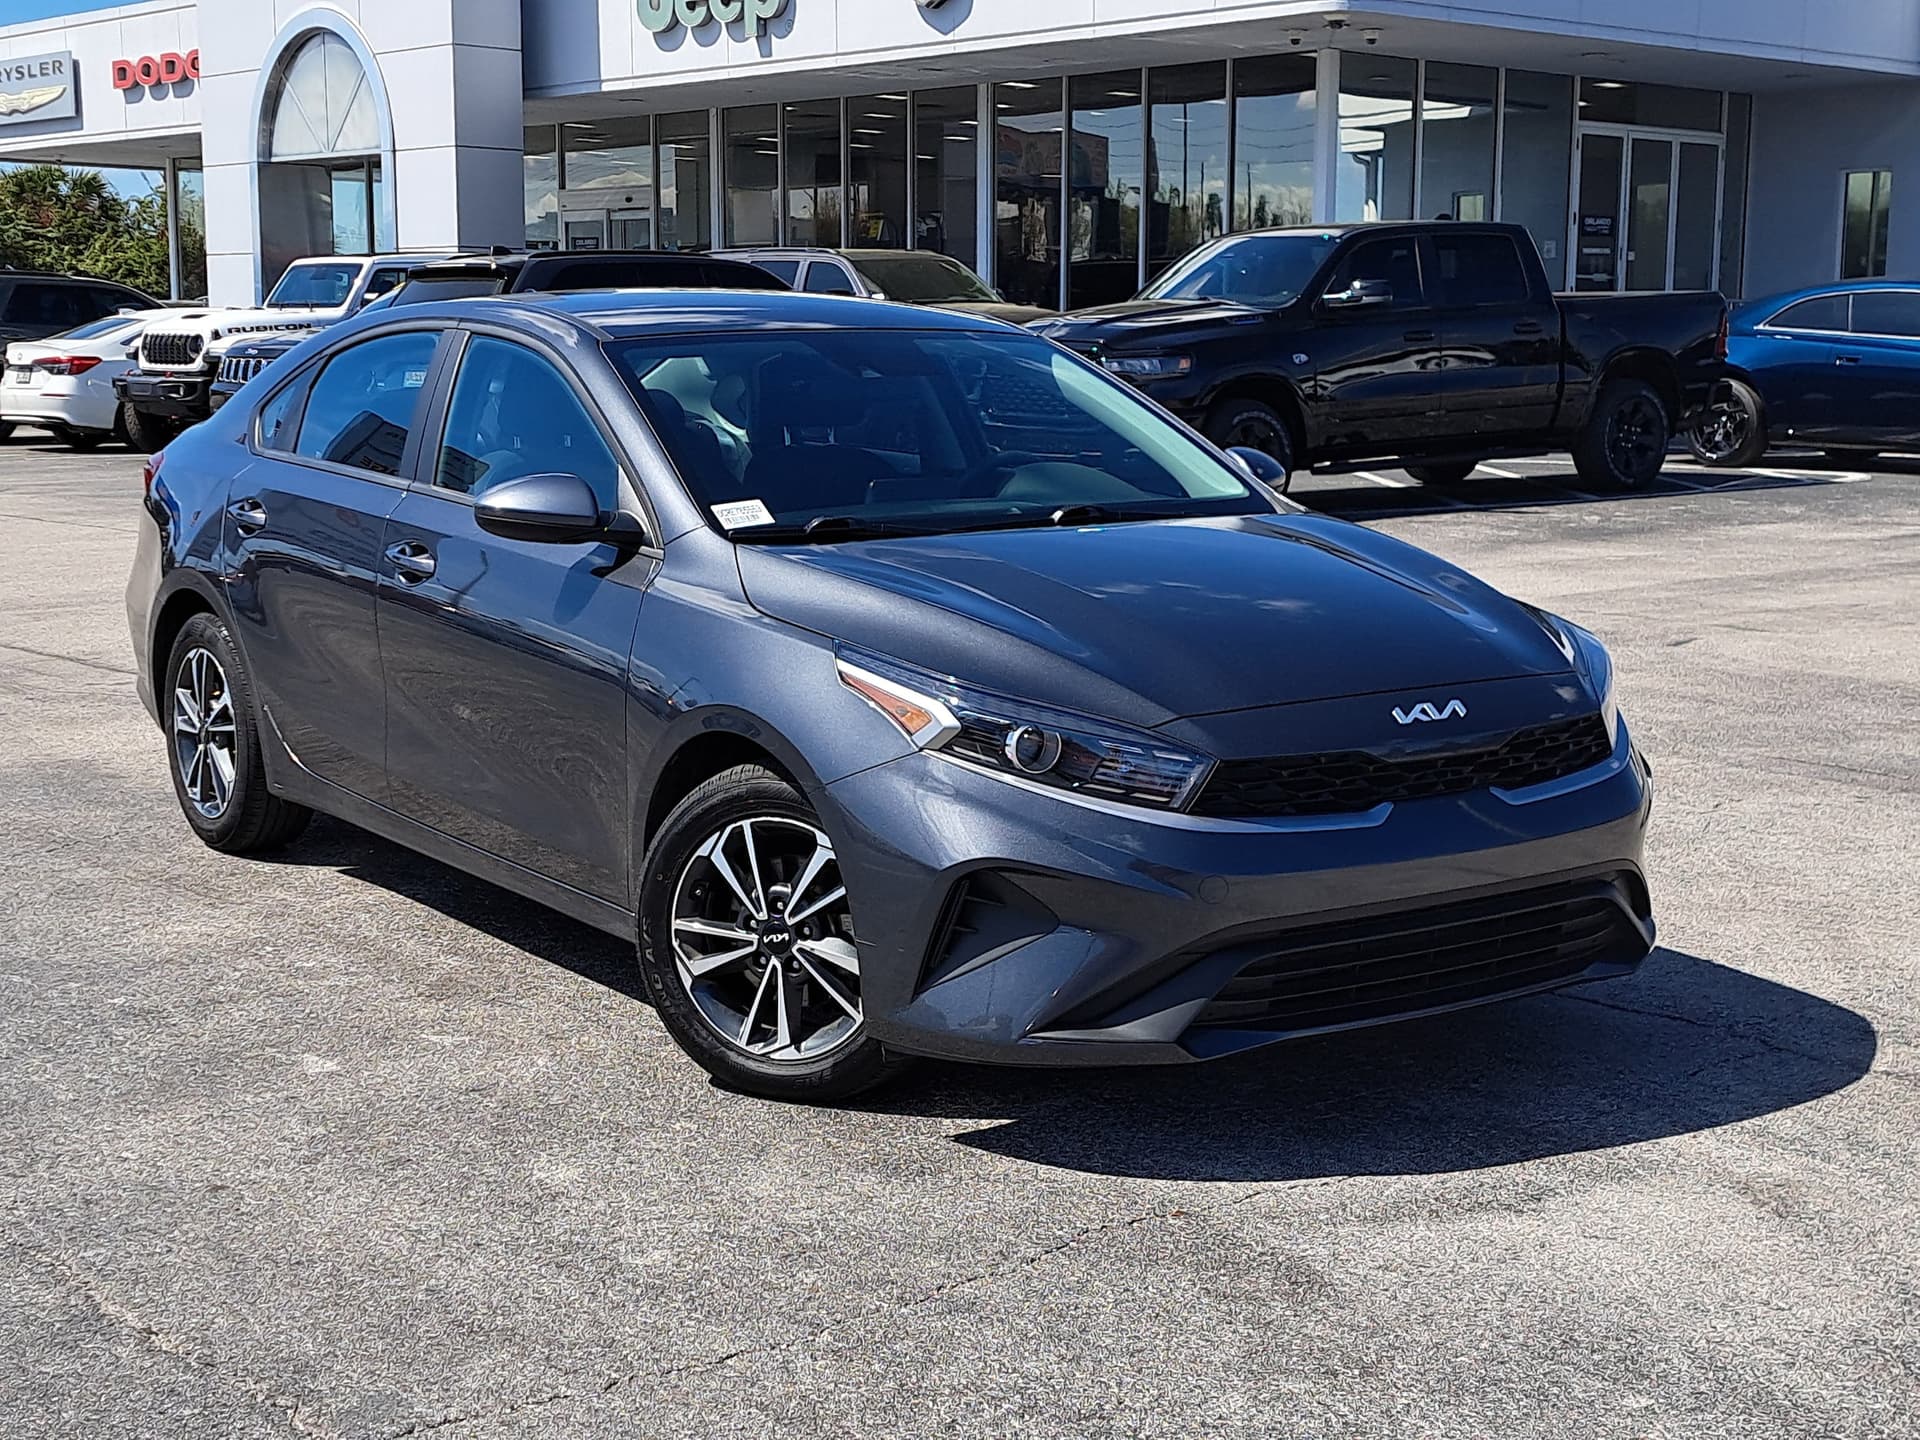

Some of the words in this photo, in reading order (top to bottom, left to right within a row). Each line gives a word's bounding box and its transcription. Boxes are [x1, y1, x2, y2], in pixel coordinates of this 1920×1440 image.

[0, 60, 64, 83] YSLER
[227, 323, 312, 334] RUBICON
[1391, 699, 1467, 724] KIA
